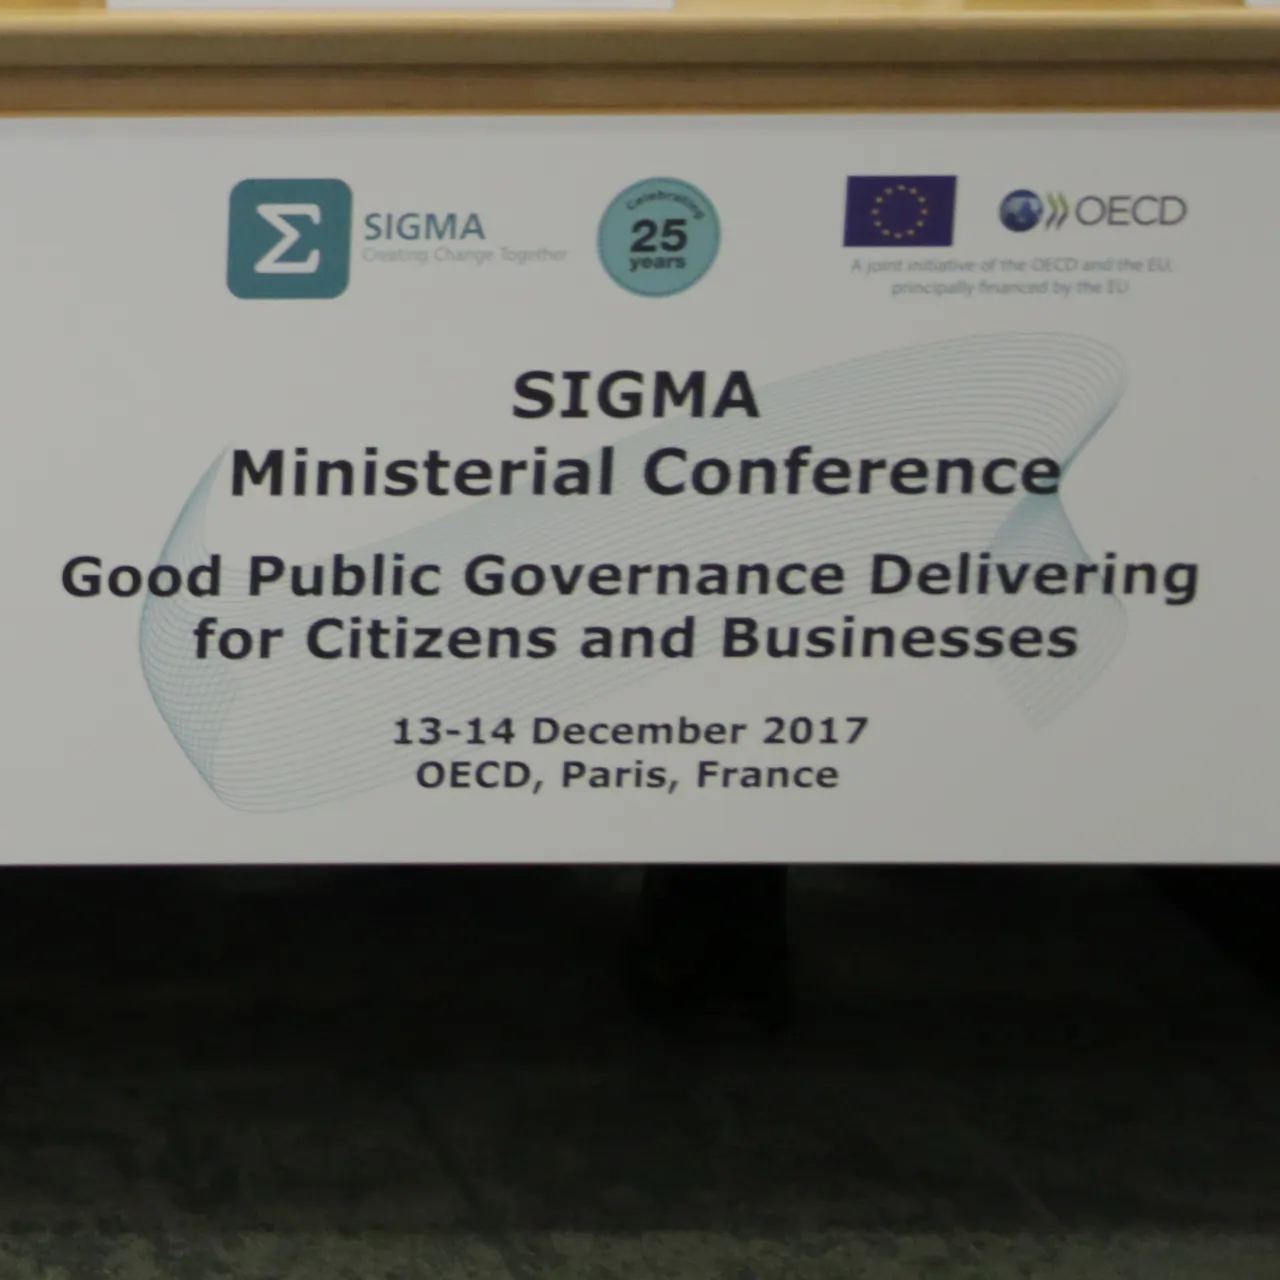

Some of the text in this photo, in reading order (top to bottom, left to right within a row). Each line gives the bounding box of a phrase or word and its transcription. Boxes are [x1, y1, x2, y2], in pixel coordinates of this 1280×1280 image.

[626, 190, 706, 221] Celebrating
[1074, 194, 1188, 227] OECD
[364, 212, 486, 241] SIGMA
[630, 218, 688, 253] 25
[362, 246, 568, 265] Creating Change Together
[629, 256, 687, 273] years
[850, 259, 862, 273] A
[866, 259, 903, 276] joint
[907, 259, 976, 273] initiative
[981, 258, 998, 273] of
[1000, 258, 1027, 272] the
[1031, 257, 1079, 272] OECD
[1082, 258, 1114, 272] and
[1116, 258, 1145, 272] the
[891, 280, 975, 297] principally
[979, 279, 1049, 295] financed
[1052, 280, 1072, 297] by
[1076, 280, 1104, 295] the
[512, 369, 761, 420] SIGMA
[231, 444, 1065, 497] Ministerial Conference
[61, 551, 1199, 607] Good Public Governance Delivering
[192, 614, 1078, 661] for Citizens and Businesses
[393, 715, 869, 746] 13-14 December 2017
[416, 759, 839, 795] OECD, Paris, France
